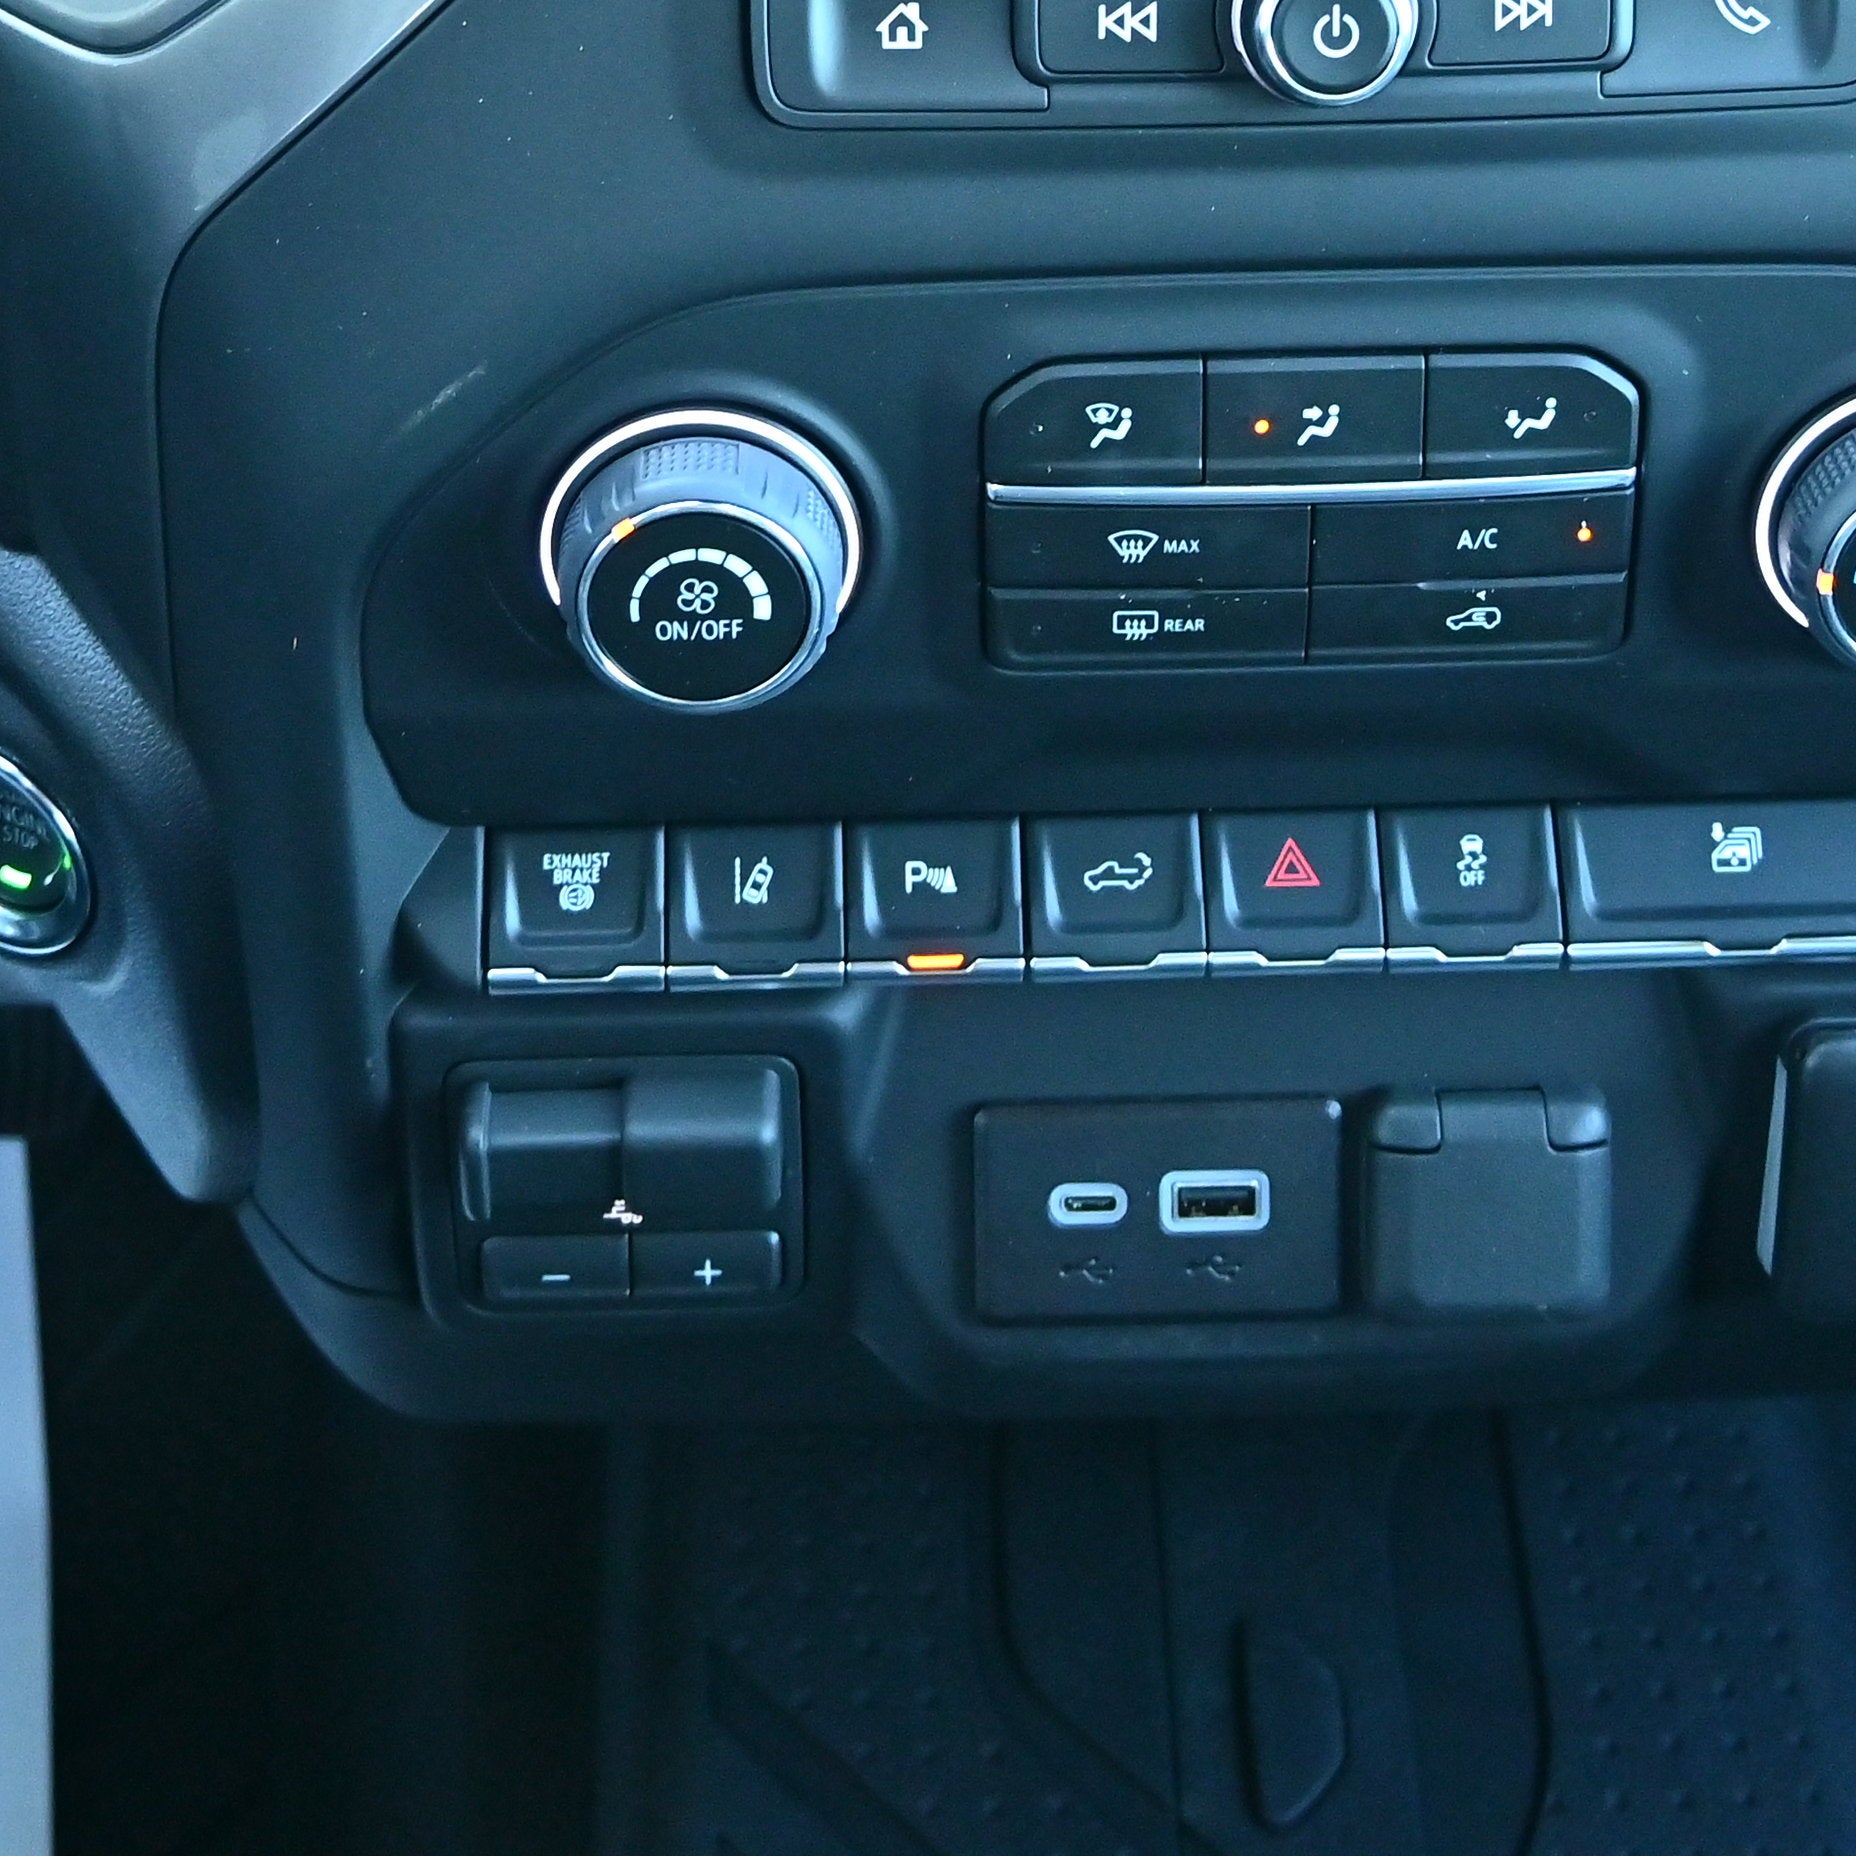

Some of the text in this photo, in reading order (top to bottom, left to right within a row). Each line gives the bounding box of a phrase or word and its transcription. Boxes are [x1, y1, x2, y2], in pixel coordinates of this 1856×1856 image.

[1163, 538, 1201, 554] MAX
[1456, 528, 1498, 550] A/C
[655, 619, 743, 641] ON/OFF
[1164, 618, 1205, 632] REAR
[543, 851, 611, 871] EXHAUST
[553, 868, 601, 885] BRAKE
[1459, 870, 1486, 887] OFF
